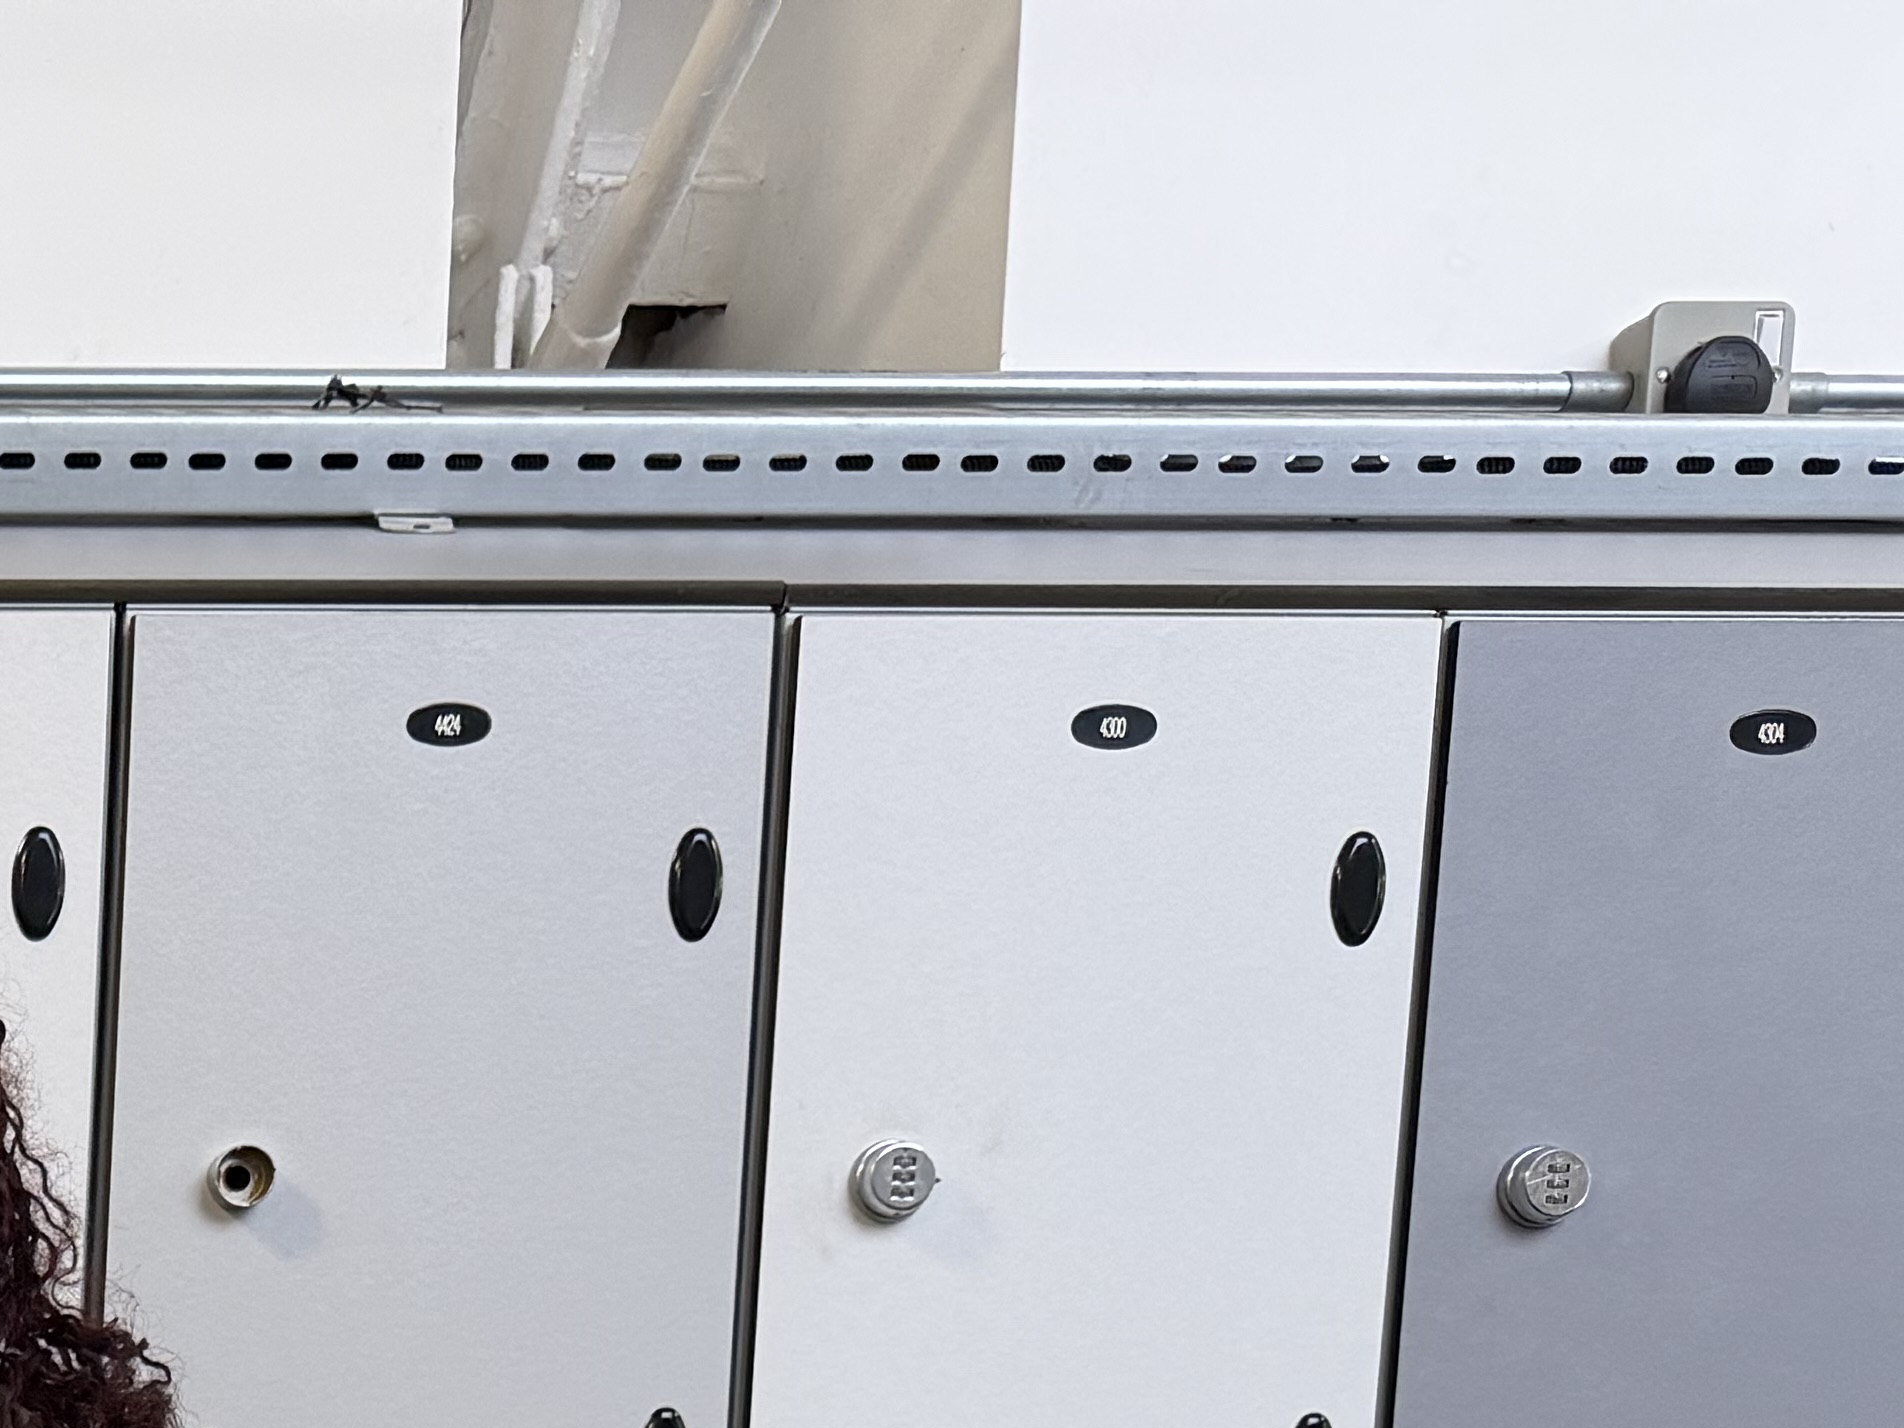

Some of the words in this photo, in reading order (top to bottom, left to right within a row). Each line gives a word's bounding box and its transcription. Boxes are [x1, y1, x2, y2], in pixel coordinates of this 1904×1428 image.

[434, 713, 462, 736] 4424
[1099, 716, 1127, 739] 4300
[1757, 722, 1785, 744] 4304
